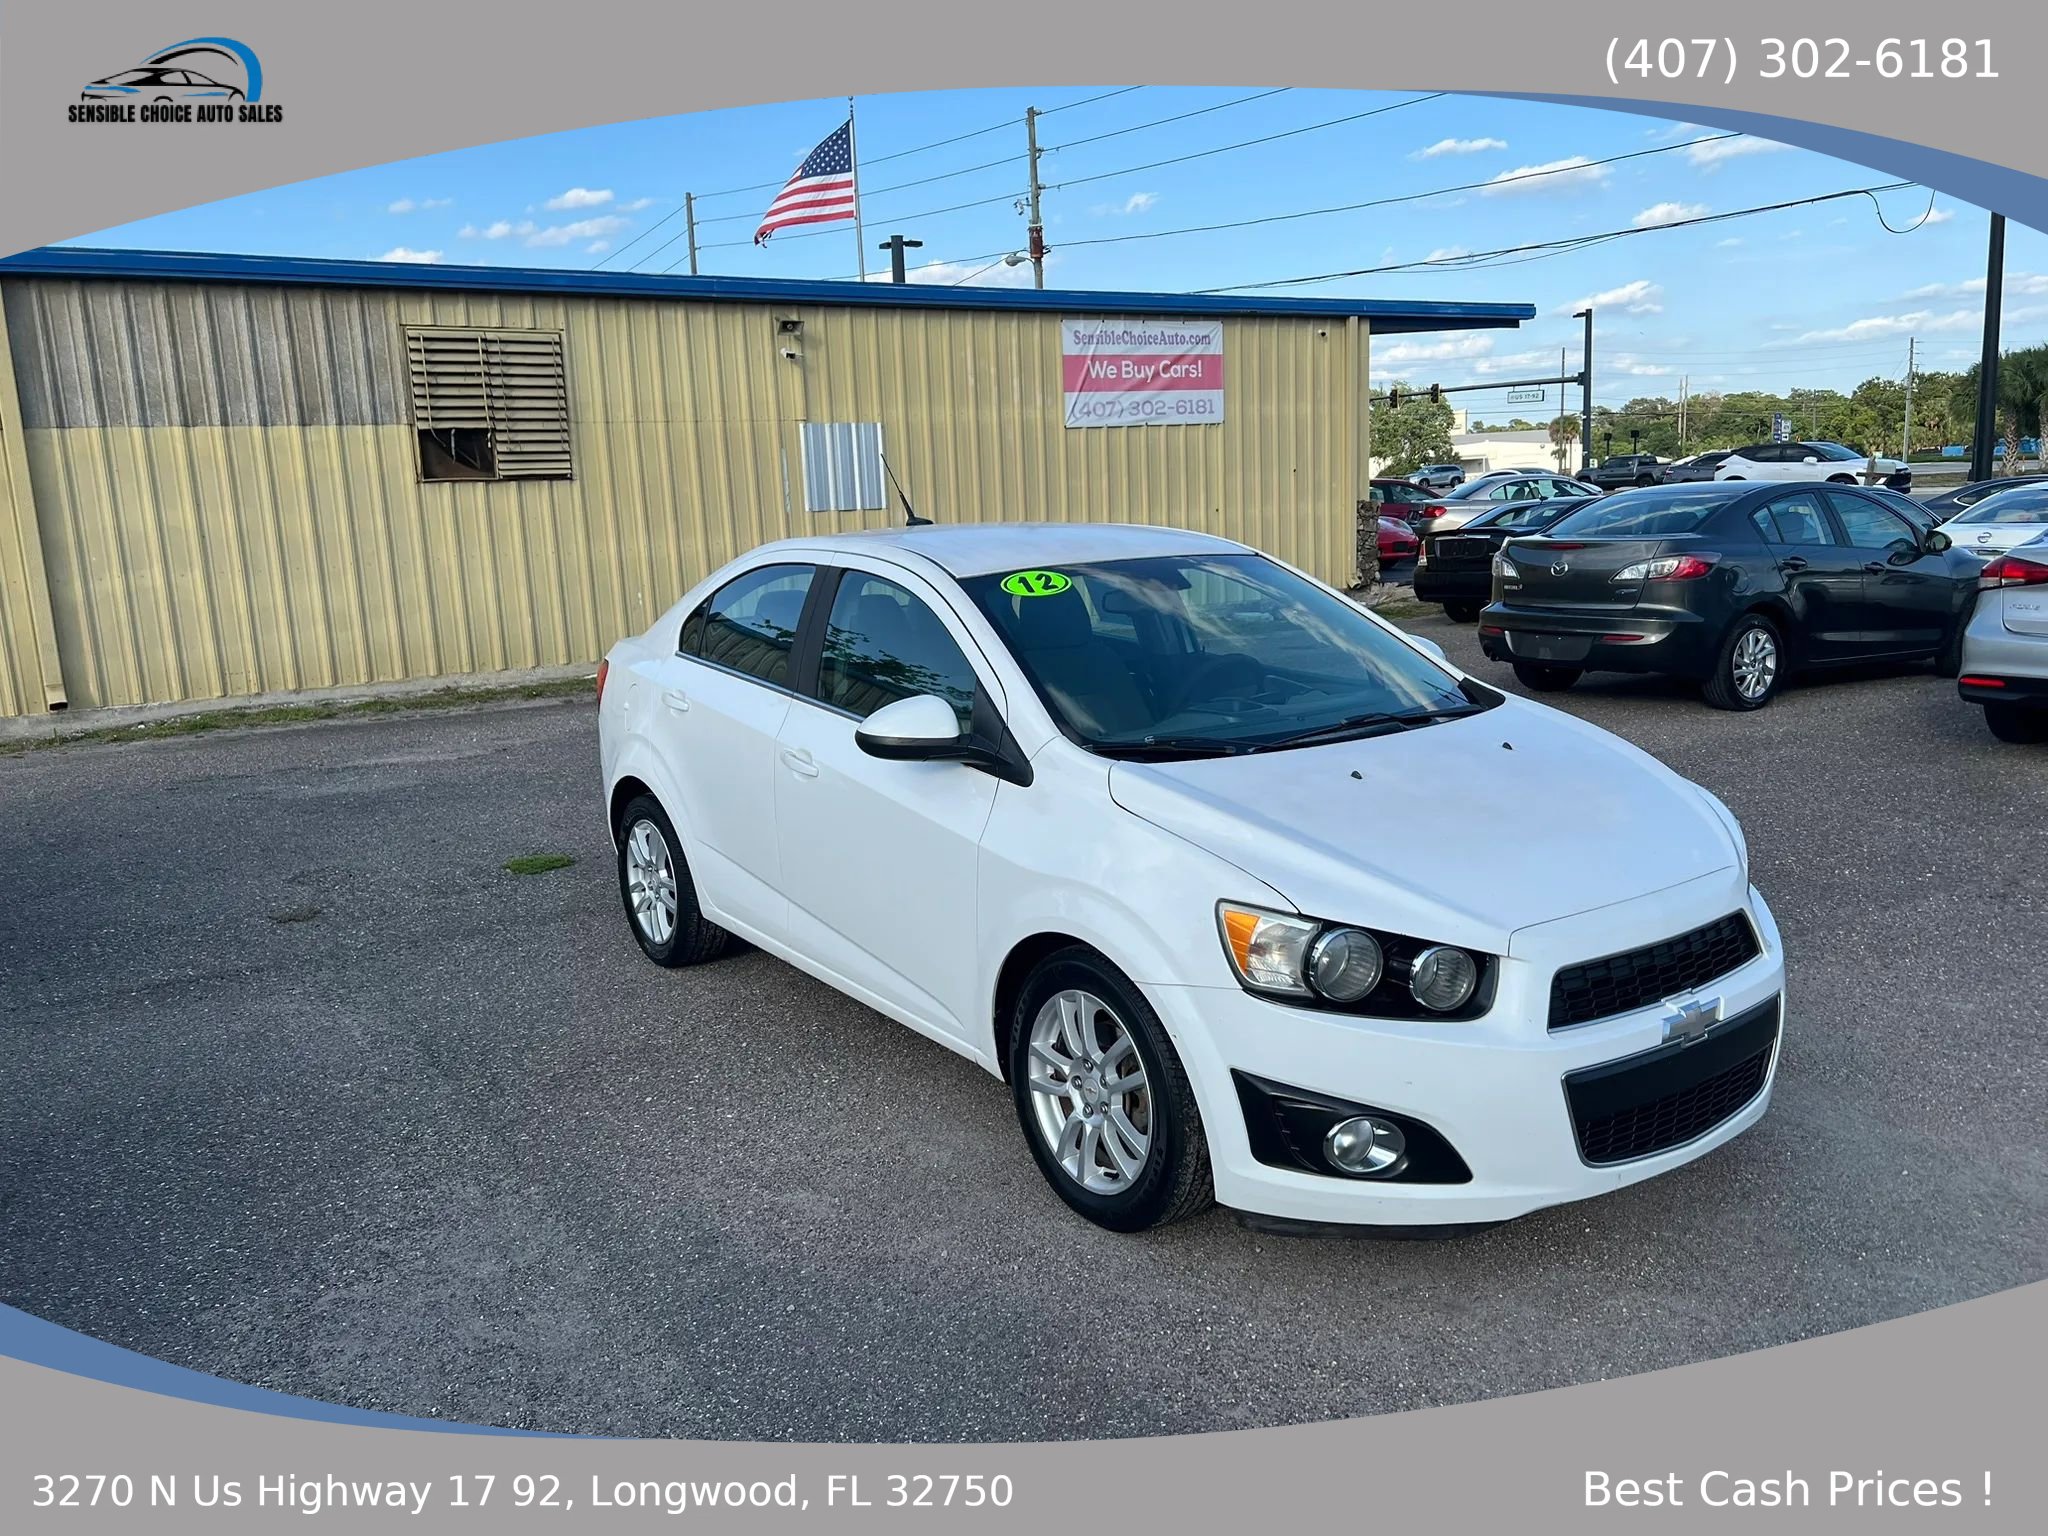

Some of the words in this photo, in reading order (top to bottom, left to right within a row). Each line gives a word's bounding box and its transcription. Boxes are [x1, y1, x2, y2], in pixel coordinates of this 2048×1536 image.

[1073, 330, 1211, 346] SensibleChoiceAuto.com
[1089, 360, 1117, 379] We
[1121, 360, 1155, 382] Buy
[1159, 360, 1202, 379] Cars!
[1071, 401, 1124, 420] (407)
[1128, 399, 1215, 416] 302-6181
[1017, 573, 1059, 593] 12
